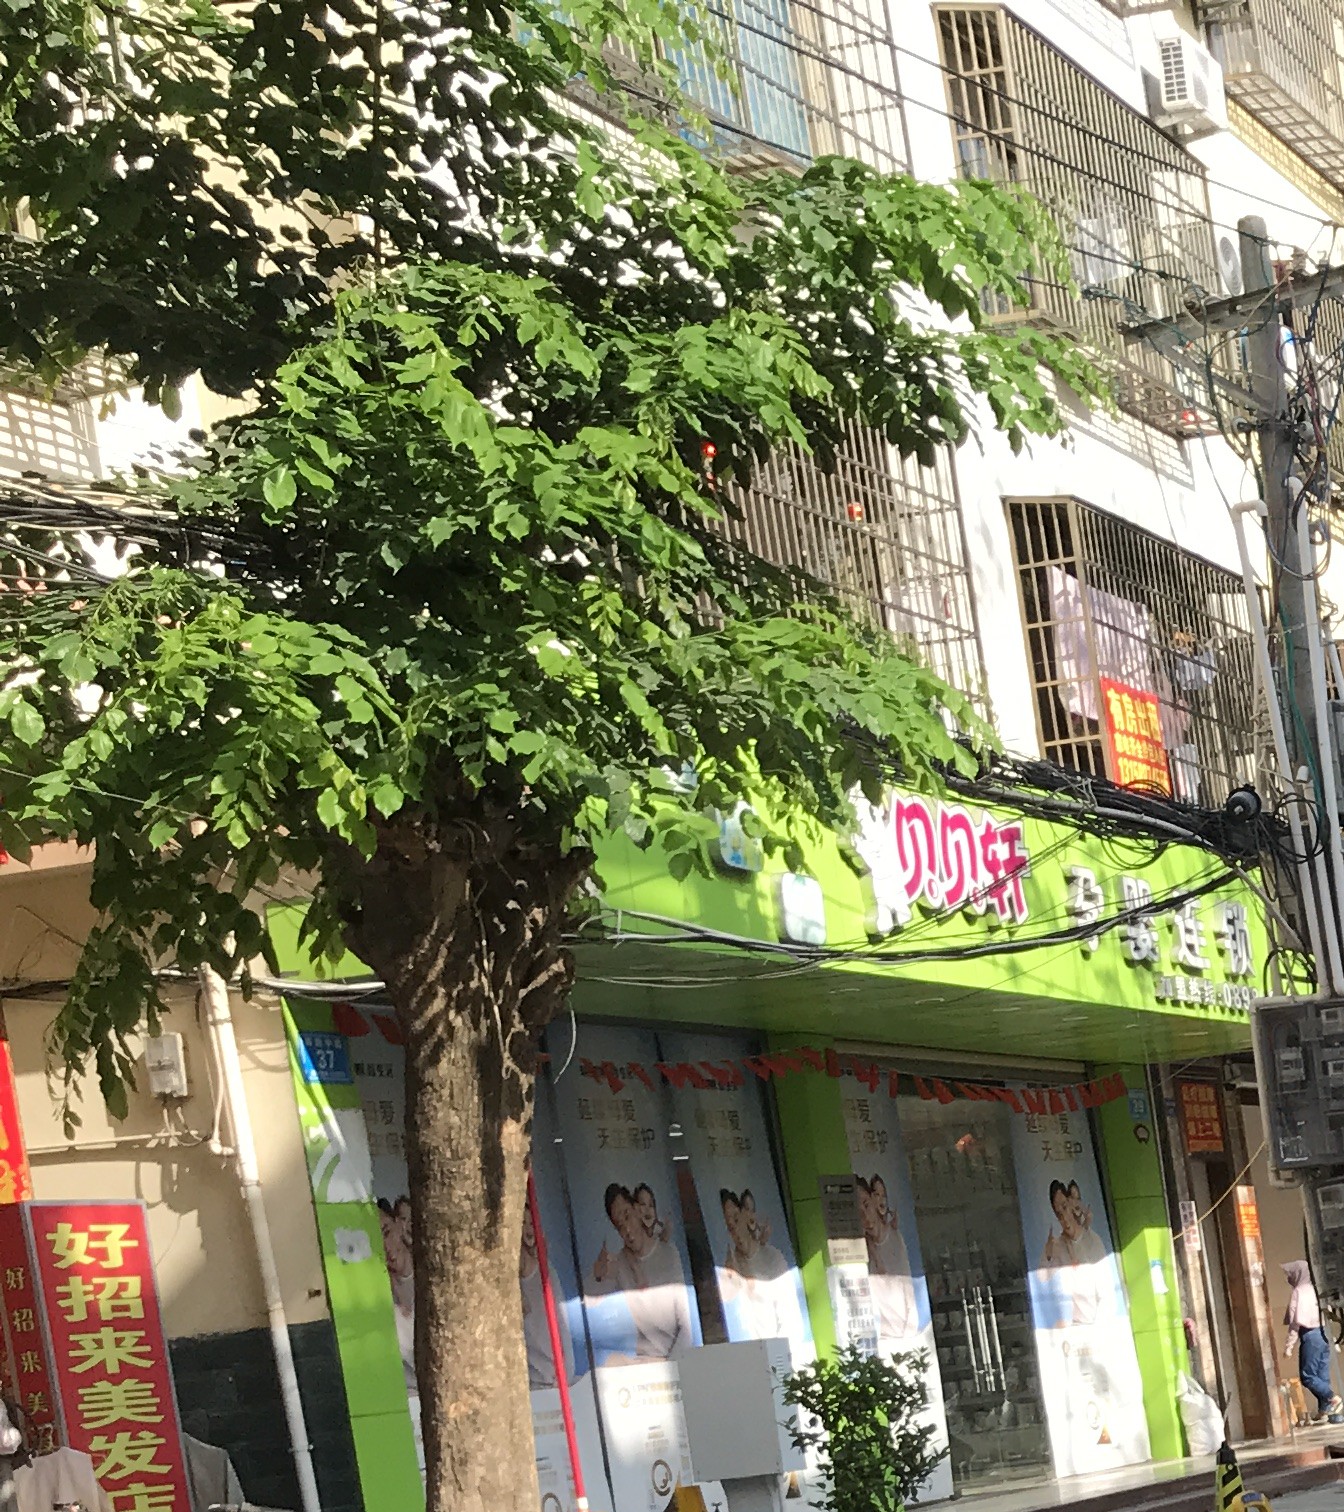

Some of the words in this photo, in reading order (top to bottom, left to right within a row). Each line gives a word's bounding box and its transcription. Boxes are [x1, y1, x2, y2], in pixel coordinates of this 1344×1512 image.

[895, 797, 1028, 924] 贝贝轩
[1068, 865, 1255, 978] 孕婴连锁
[316, 1048, 335, 1069] 37
